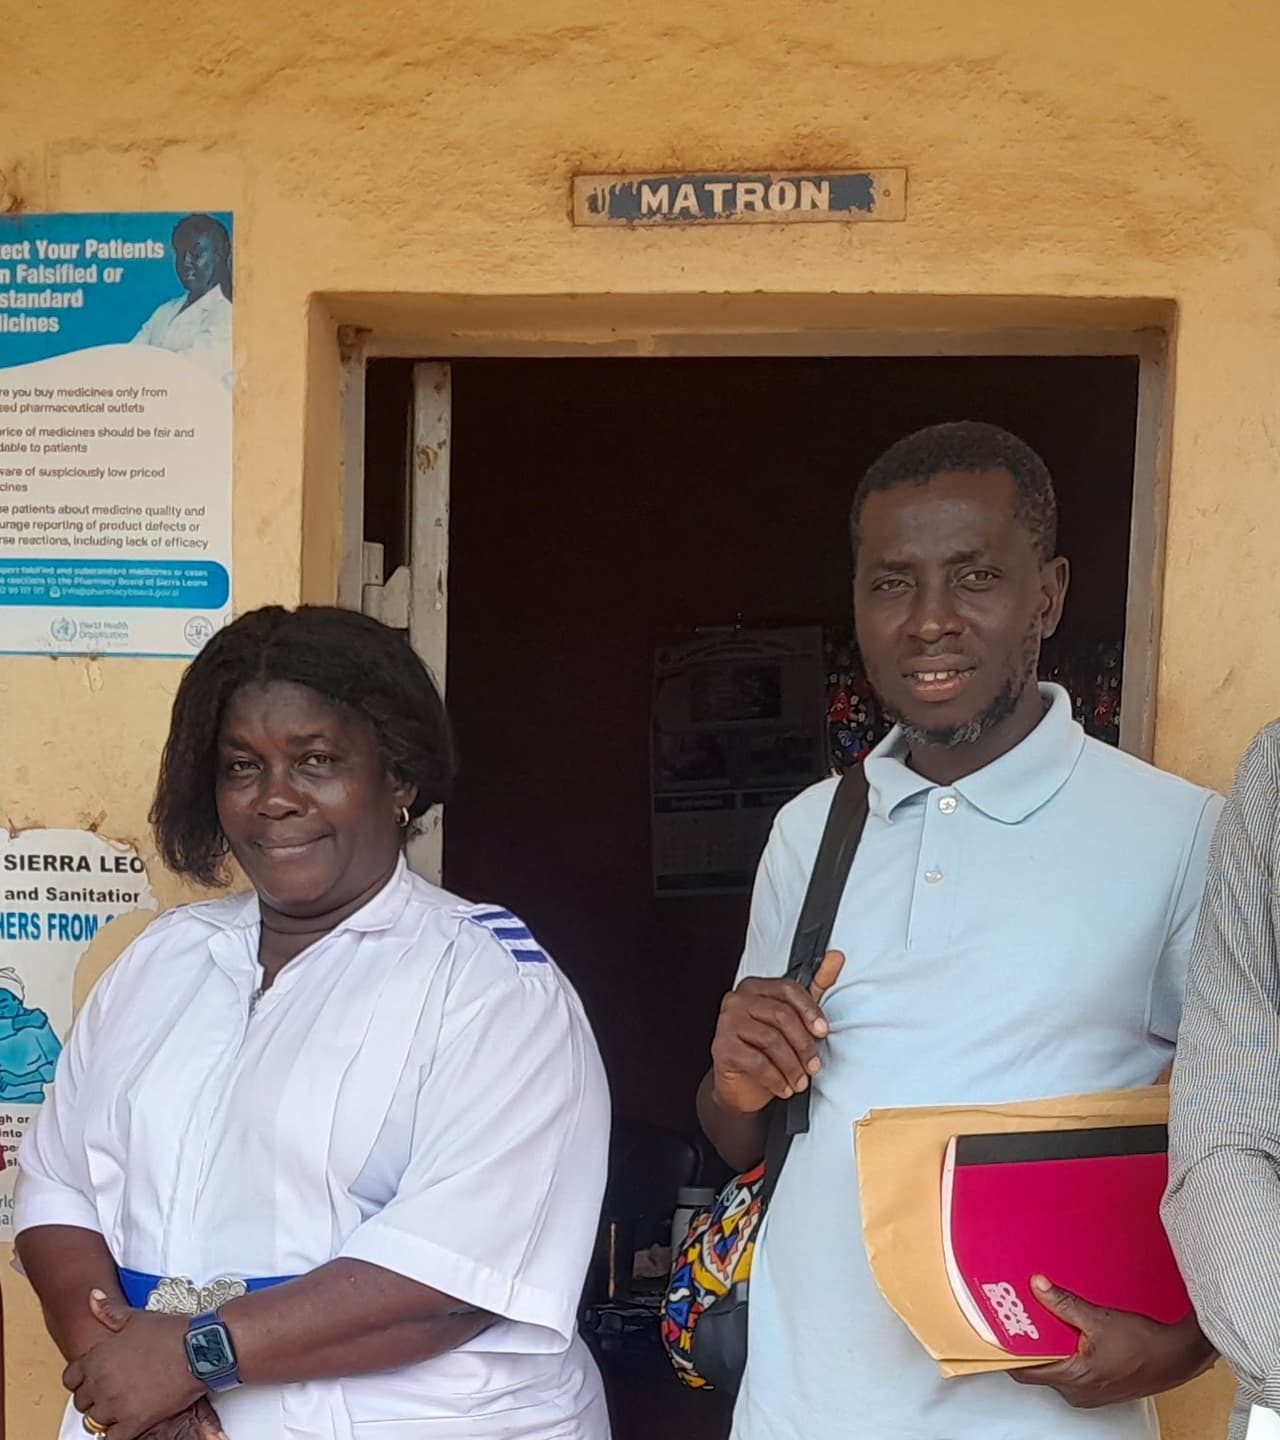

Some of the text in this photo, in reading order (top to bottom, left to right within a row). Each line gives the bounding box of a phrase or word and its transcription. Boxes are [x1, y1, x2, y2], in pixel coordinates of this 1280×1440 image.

[640, 181, 830, 216] MATRON
[36, 240, 80, 259] Your
[85, 238, 165, 259] Patients
[16, 264, 97, 284] Falsified
[103, 267, 124, 283] or
[12, 389, 32, 400] you
[34, 387, 54, 399] buy
[56, 387, 113, 397] medicines
[116, 387, 139, 399] only
[142, 386, 168, 397] from
[107, 403, 145, 413] outlets
[25, 426, 36, 437] of
[39, 427, 95, 437] medicines
[98, 427, 134, 438] should
[136, 427, 151, 438] be
[173, 428, 195, 438] and
[30, 443, 41, 453] to
[43, 443, 88, 455] patients
[25, 466, 36, 477] of
[39, 467, 105, 479] suspiciously
[108, 467, 127, 477] low
[130, 467, 166, 479] priced
[12, 504, 56, 516] patients
[58, 504, 90, 514] about
[92, 505, 143, 515] medicine
[145, 505, 182, 518] quality
[184, 506, 206, 516] and
[32, 520, 83, 532] reporting
[86, 520, 97, 530] of
[99, 520, 142, 532] product
[145, 521, 187, 532] defects
[189, 523, 200, 532] or
[73, 536, 124, 549] including
[125, 536, 148, 547] lack
[151, 536, 162, 547] of
[165, 537, 209, 550] efficacy
[4, 855, 91, 872] SIERRA
[100, 856, 145, 873] LEO
[5, 887, 39, 901] and
[48, 913, 99, 941] FROM
[981, 1283, 1025, 1337] BOOK
[997, 1281, 1040, 1340] COMP
